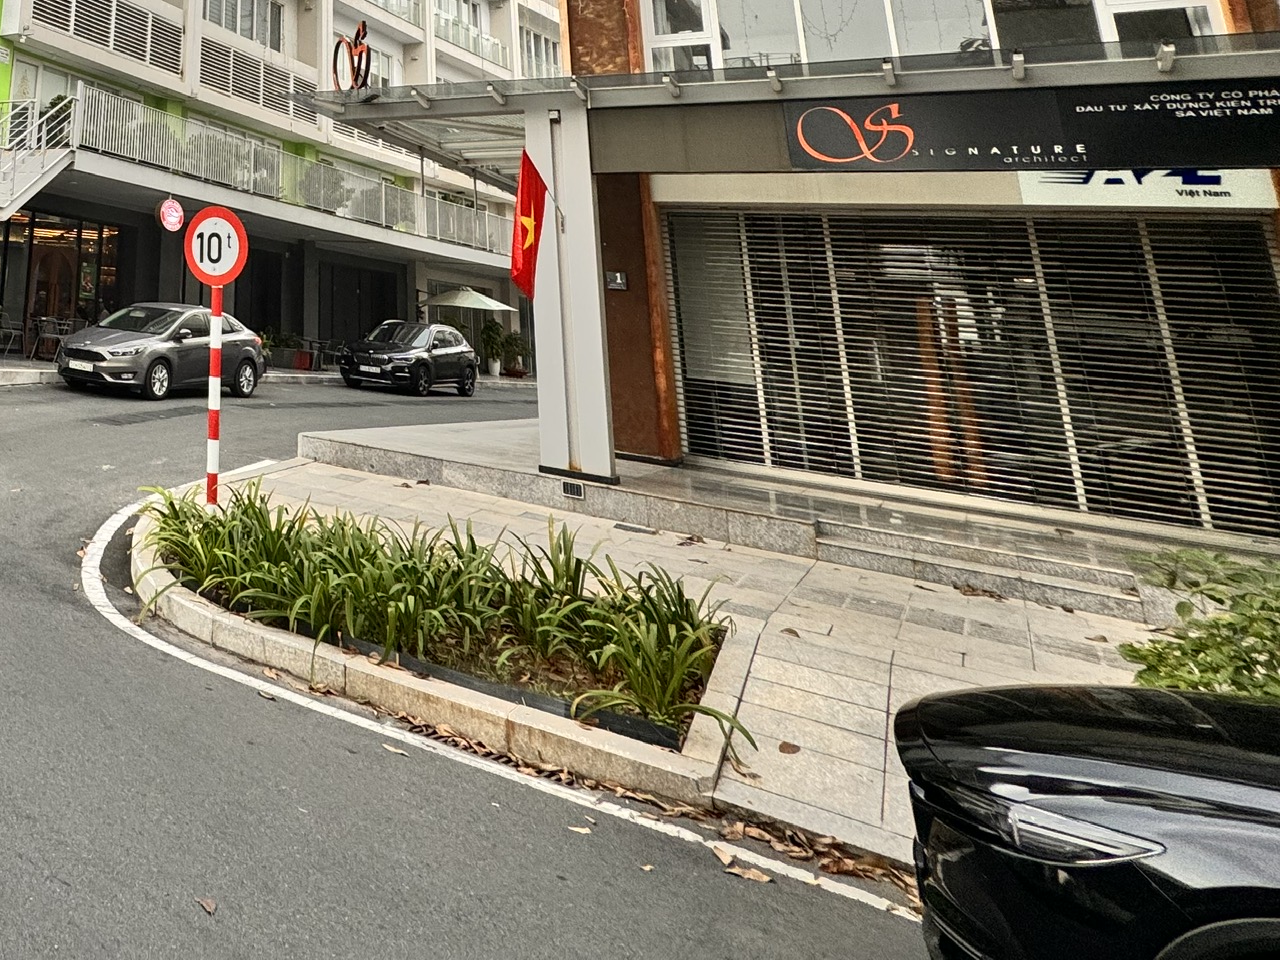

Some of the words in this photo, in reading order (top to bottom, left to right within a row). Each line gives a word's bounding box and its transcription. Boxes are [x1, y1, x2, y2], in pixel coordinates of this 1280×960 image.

[1197, 91, 1215, 100] TY
[1175, 109, 1197, 118] SA
[1237, 107, 1274, 116] NAM
[911, 144, 1087, 156] SIGNATURE
[1004, 153, 1088, 164] architect
[1175, 189, 1200, 198] Việt
[1203, 189, 1231, 198] Nam
[196, 231, 222, 264] 10
[615, 272, 623, 283] 1
